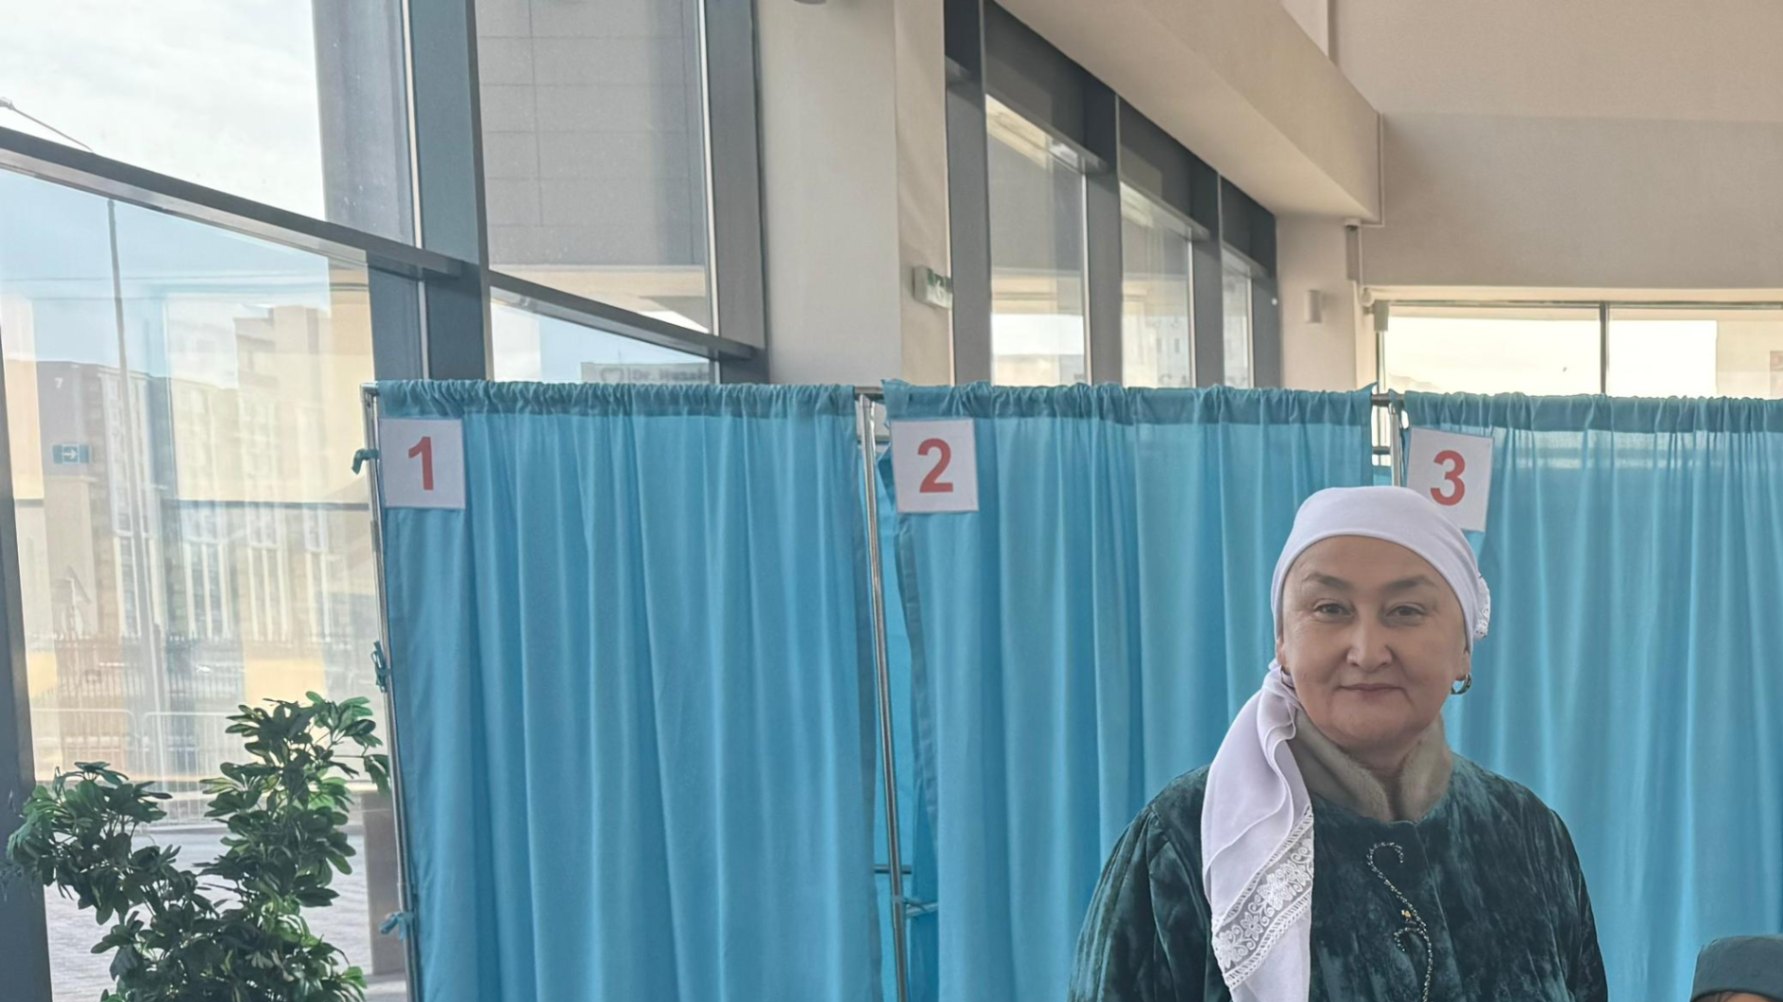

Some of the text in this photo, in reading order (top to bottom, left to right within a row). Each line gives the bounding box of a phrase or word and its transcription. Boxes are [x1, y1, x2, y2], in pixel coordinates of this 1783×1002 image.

[408, 436, 435, 491] 1
[918, 438, 953, 494] 2
[1430, 450, 1467, 507] 3
